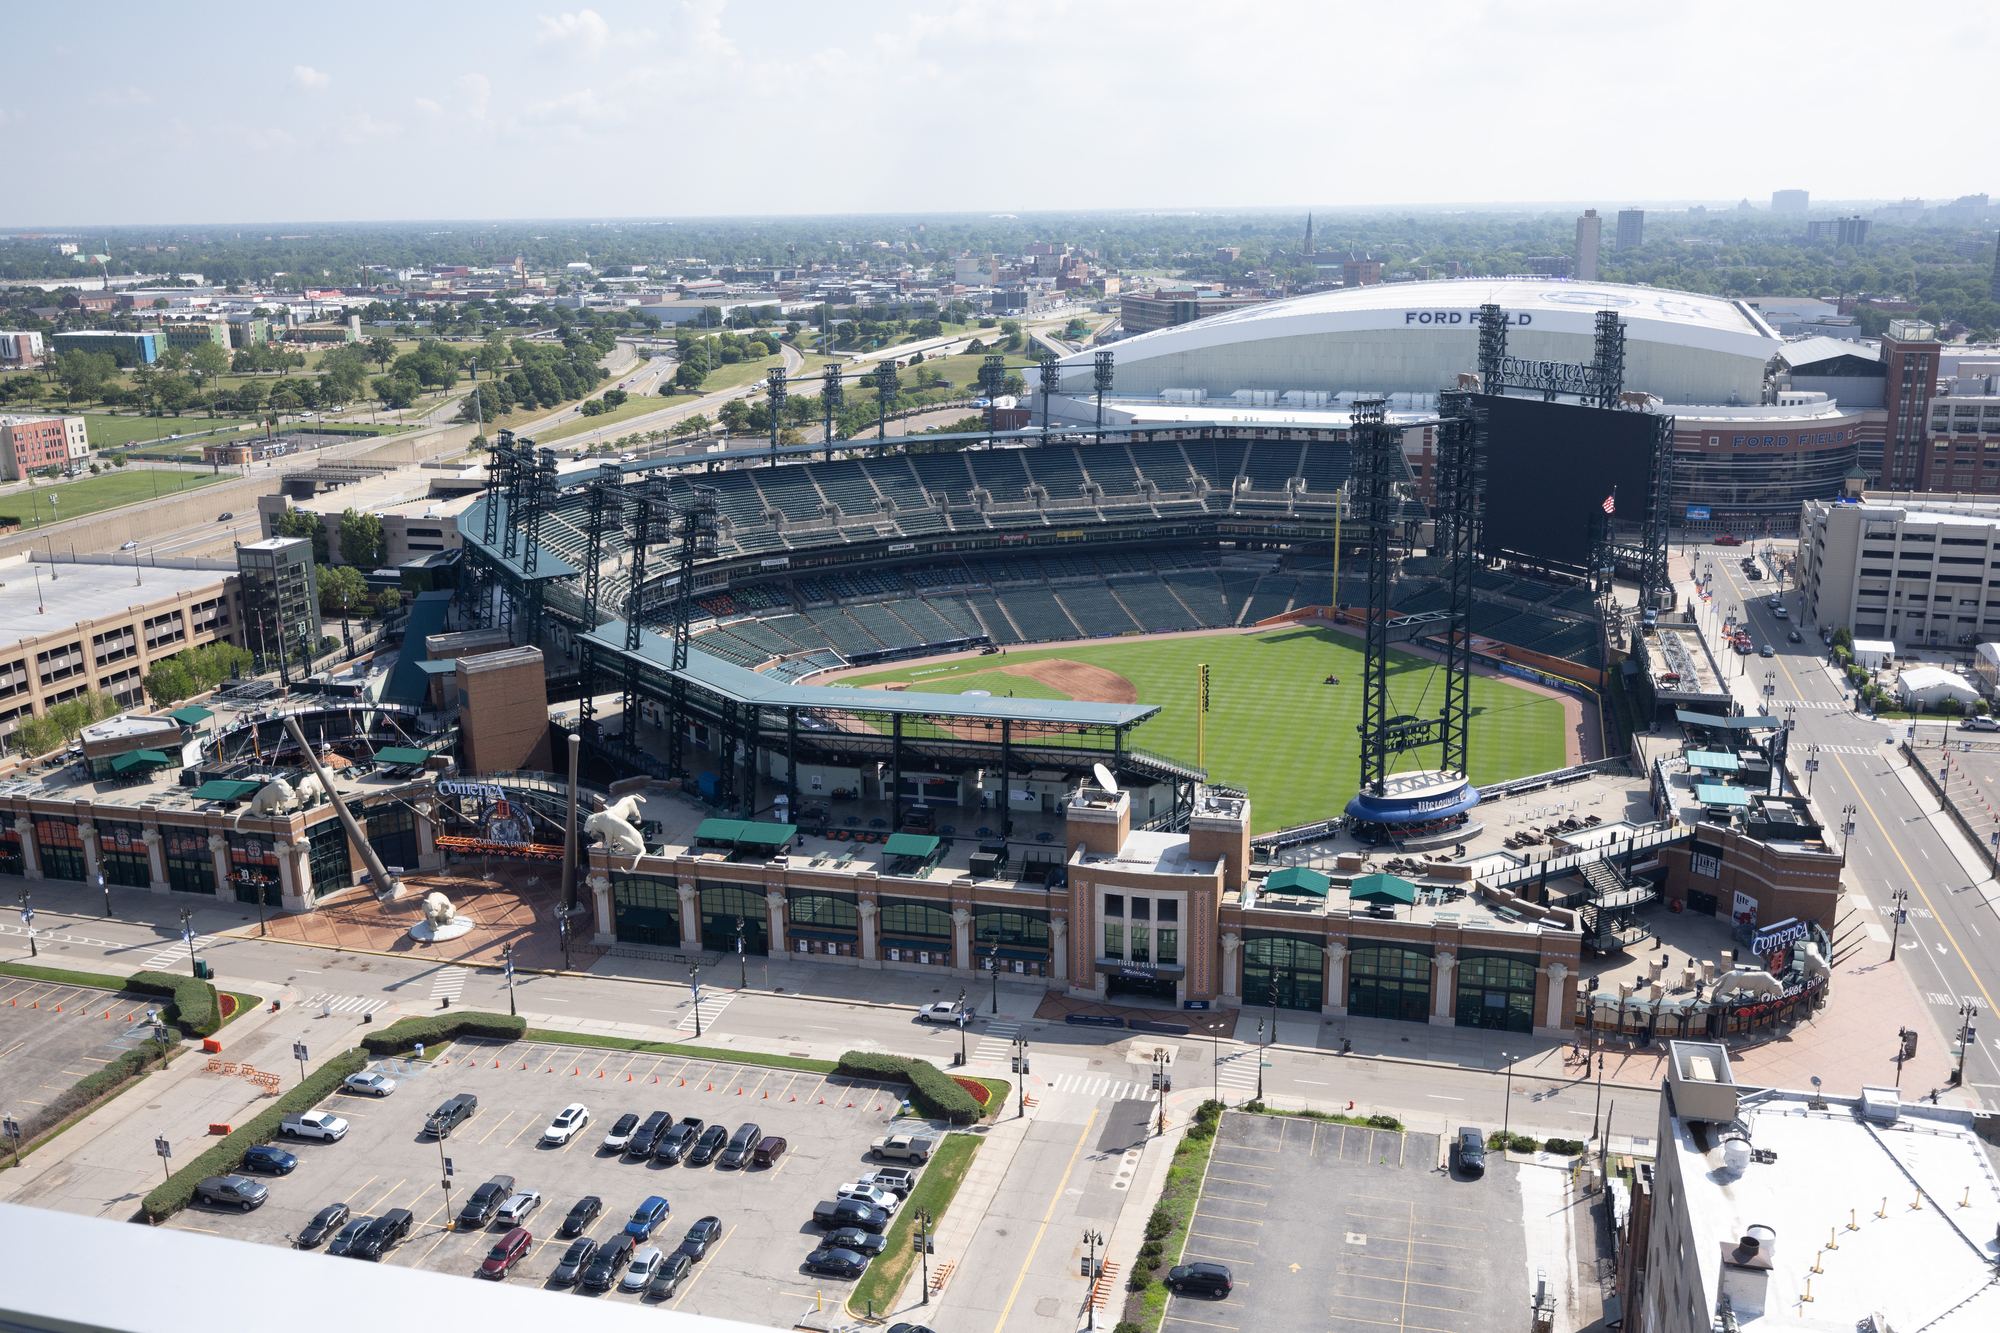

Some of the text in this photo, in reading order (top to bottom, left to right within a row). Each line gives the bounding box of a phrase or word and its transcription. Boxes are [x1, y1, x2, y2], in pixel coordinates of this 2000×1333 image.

[1405, 312, 1462, 324] FORD
[1732, 431, 1844, 448] FORD FIELD
[1545, 678, 1559, 687] DTE
[1736, 893, 1749, 906] Lite
[1909, 907, 1933, 919] ONLY
[1926, 992, 1953, 1006] ONLY
[1960, 995, 1989, 1009] ONLY
